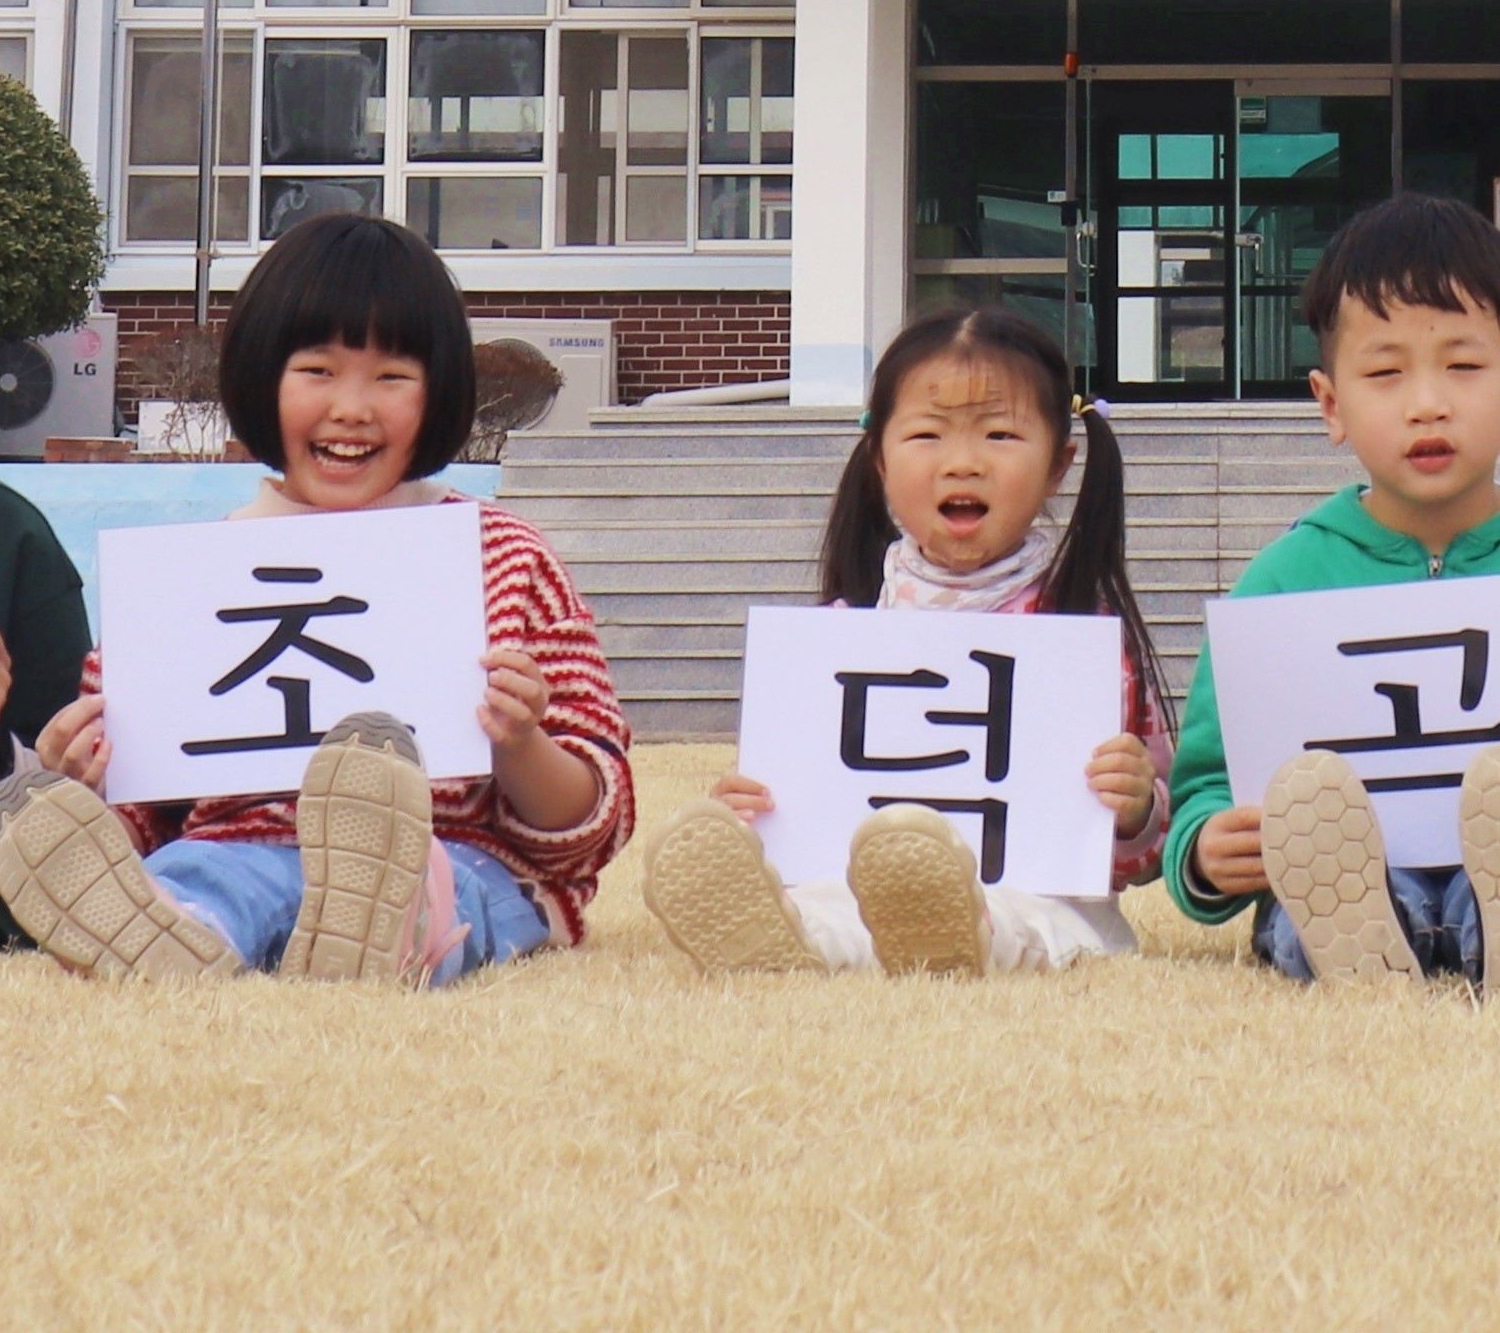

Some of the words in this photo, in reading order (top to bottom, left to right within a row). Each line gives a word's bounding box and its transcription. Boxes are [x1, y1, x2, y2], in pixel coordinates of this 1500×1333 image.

[73, 362, 97, 376] LG
[549, 337, 604, 347] SAMSUNG
[180, 566, 416, 756] 초
[833, 649, 1016, 885] 덕
